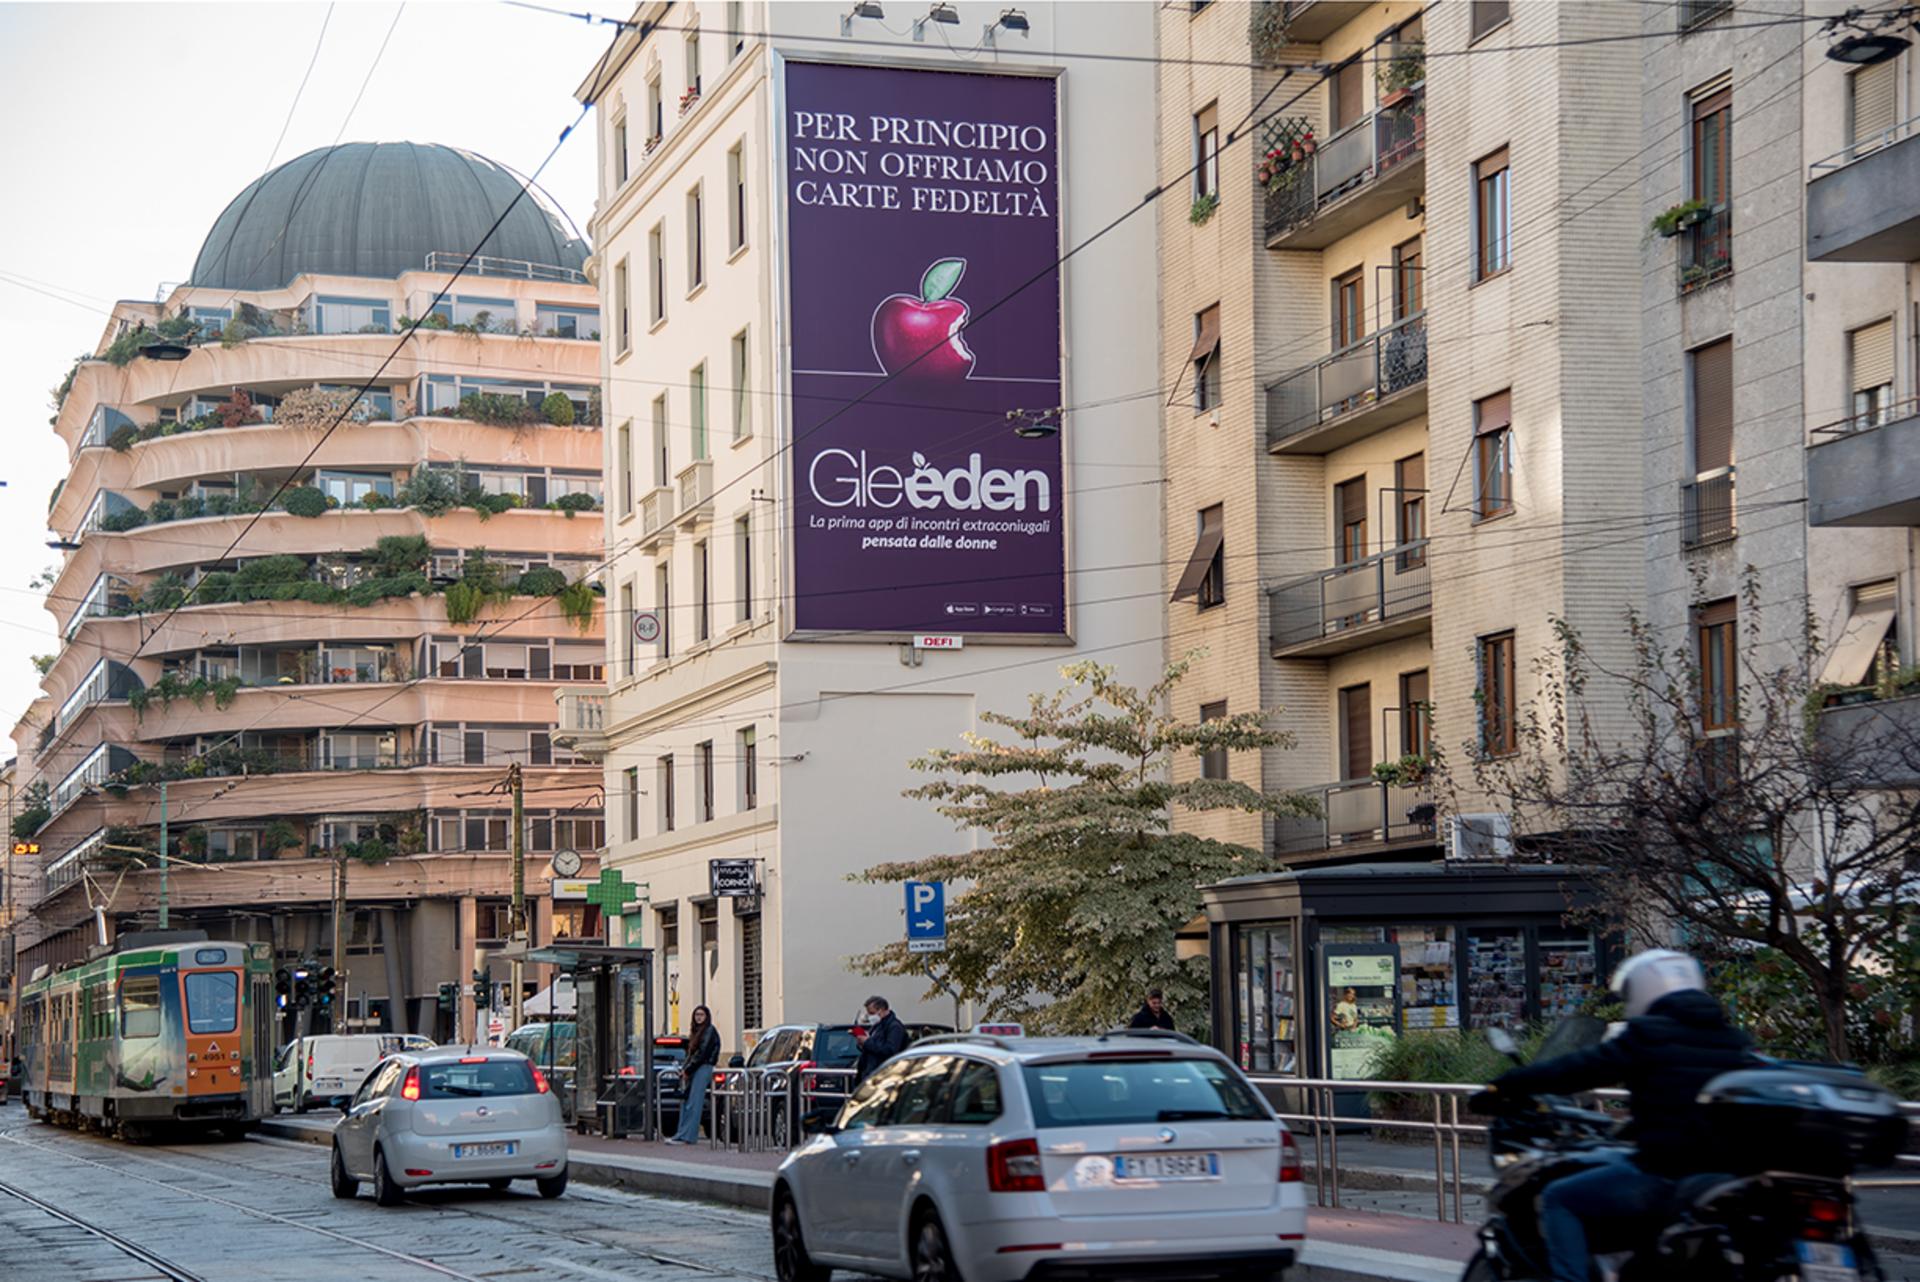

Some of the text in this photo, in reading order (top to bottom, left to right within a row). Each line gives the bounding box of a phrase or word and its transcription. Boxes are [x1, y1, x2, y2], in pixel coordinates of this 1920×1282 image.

[793, 111, 1047, 152] PER PRINCIPIO
[794, 147, 1048, 185] NON OFFRIAMO
[796, 180, 1049, 217] CARTE FEDELTÀ
[810, 514, 1051, 536] La prima app di incontri extraconiugali
[862, 534, 998, 550] pensata dalle donne
[913, 885, 936, 913] P
